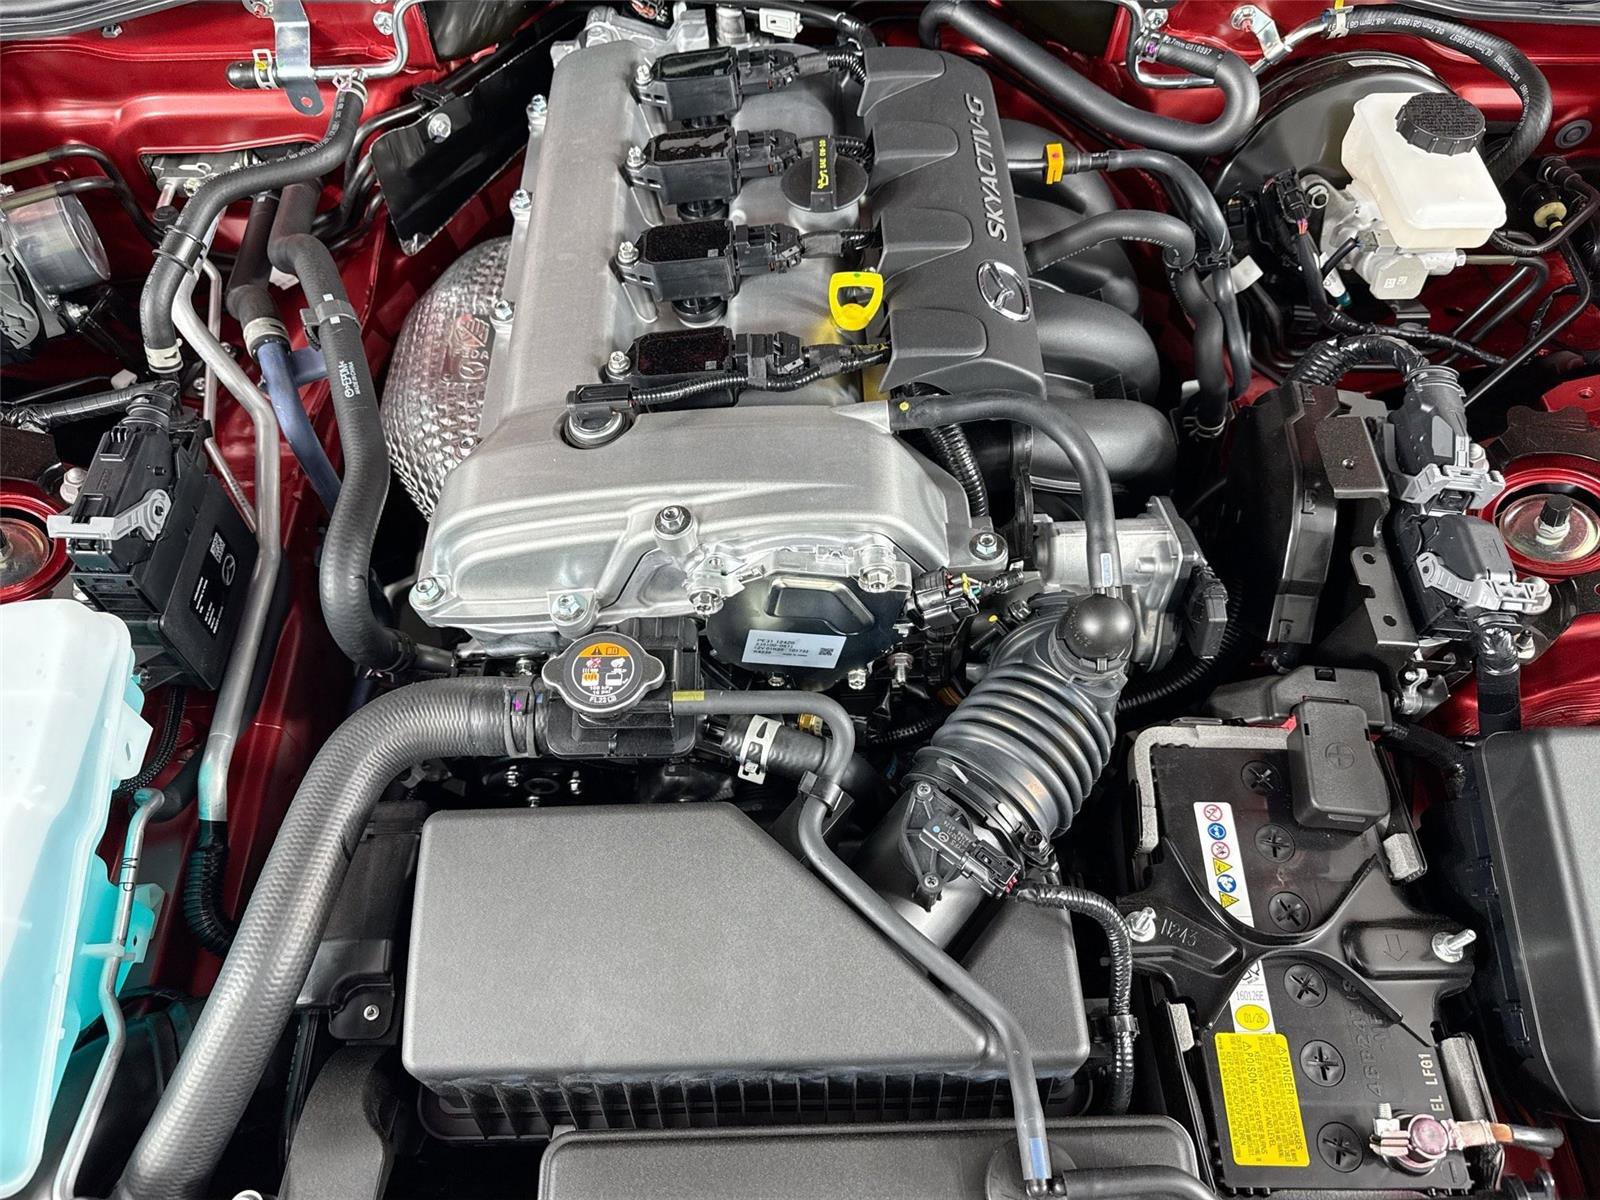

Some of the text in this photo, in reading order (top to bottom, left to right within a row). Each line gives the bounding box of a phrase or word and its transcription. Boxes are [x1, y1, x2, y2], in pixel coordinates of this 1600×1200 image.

[965, 93, 1007, 243] SKYACTIV-G
[1244, 1052, 1257, 1084] POISON
[1279, 1056, 1294, 1094] DANGER
